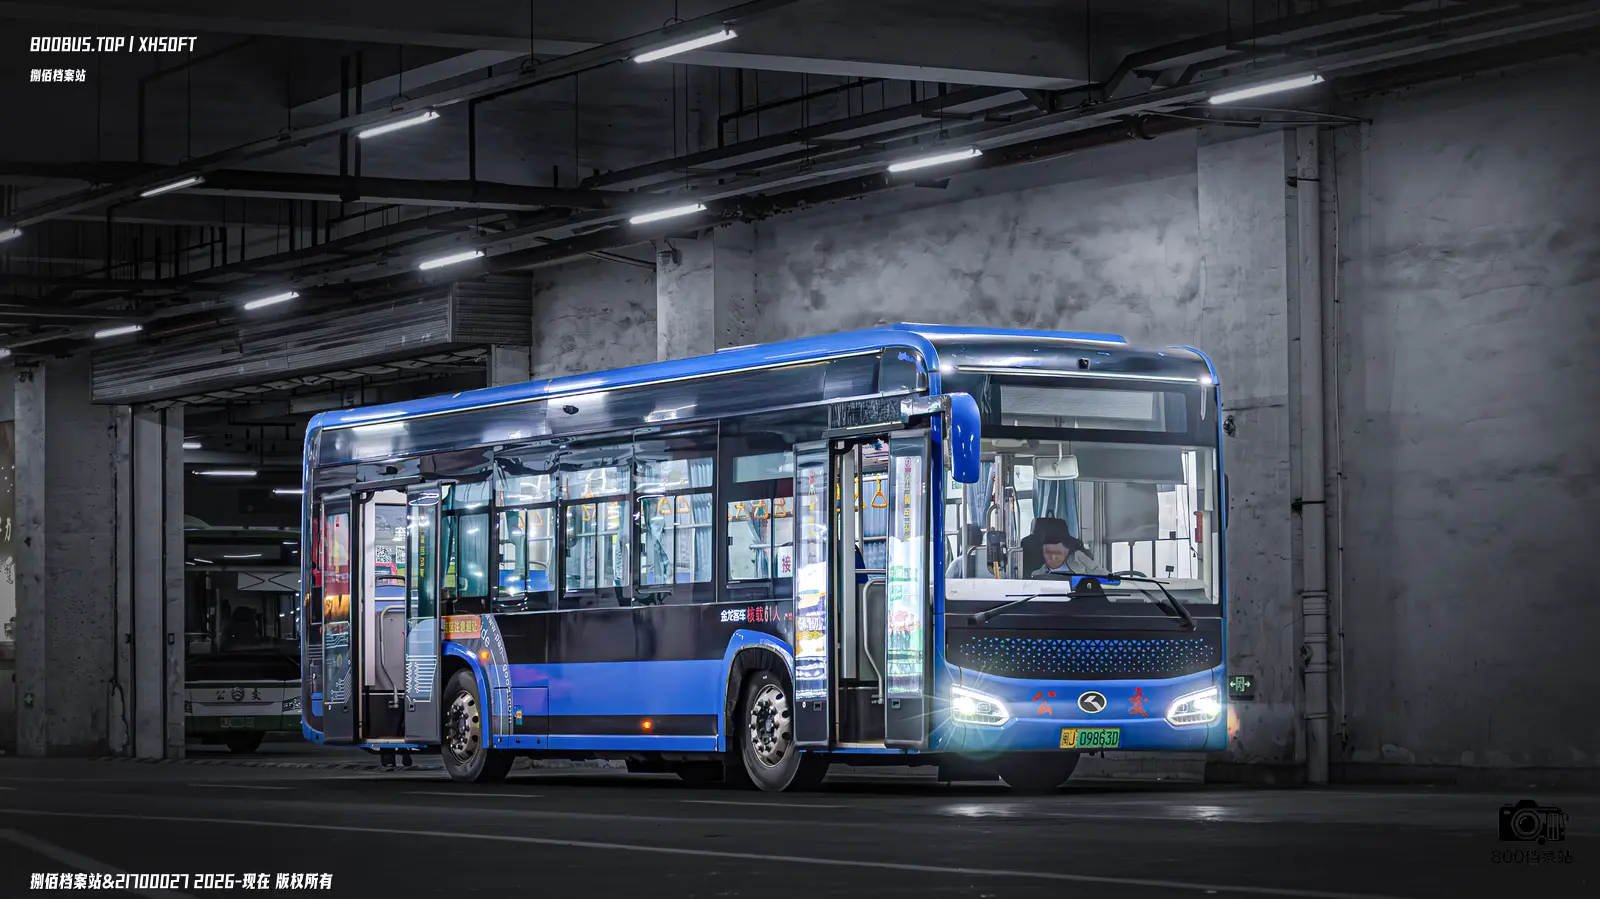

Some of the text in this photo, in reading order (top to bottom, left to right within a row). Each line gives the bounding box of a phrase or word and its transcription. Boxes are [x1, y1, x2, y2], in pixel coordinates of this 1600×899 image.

[720, 609, 746, 622] 金龙客车
[747, 605, 781, 623] 核载61人
[215, 688, 261, 700] 公 交
[1032, 687, 1149, 718] 公 交
[1079, 731, 1119, 746] 09863D
